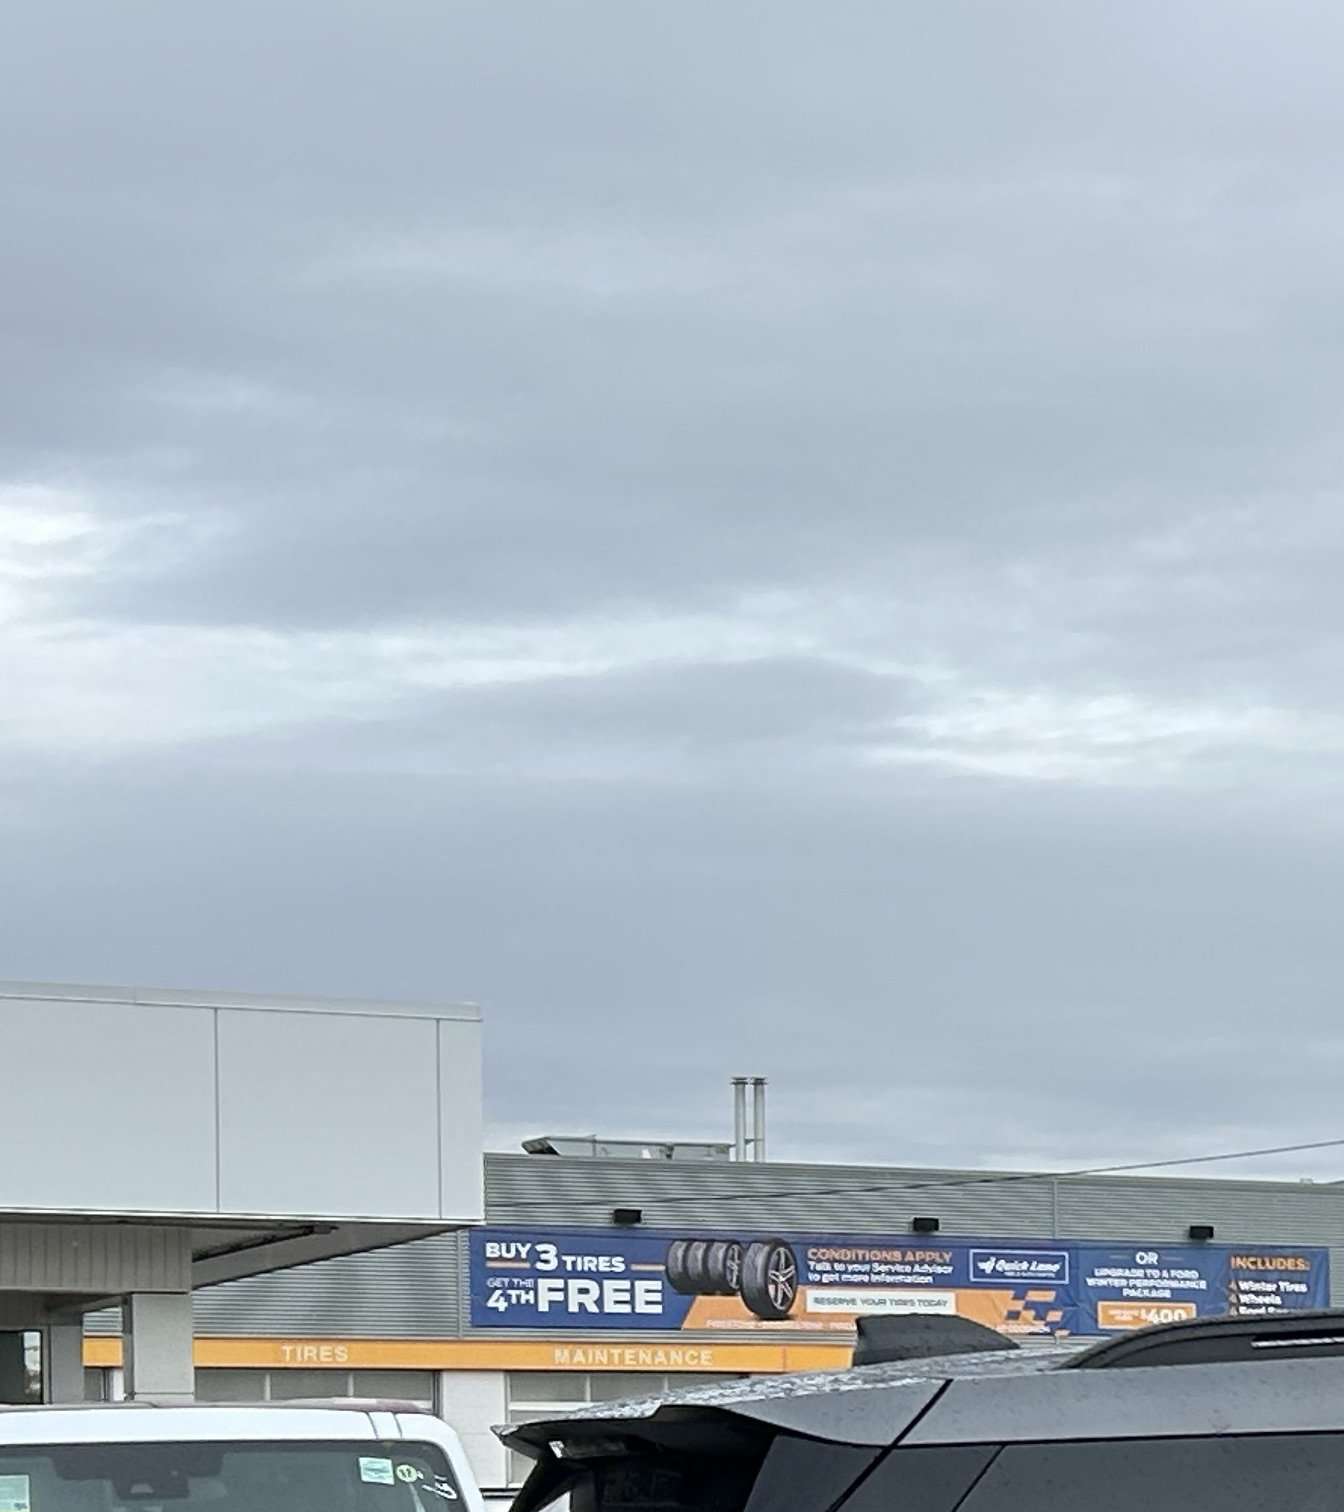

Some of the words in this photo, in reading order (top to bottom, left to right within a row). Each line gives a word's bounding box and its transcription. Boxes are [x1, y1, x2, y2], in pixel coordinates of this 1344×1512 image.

[485, 1242, 532, 1259] BUY
[535, 1243, 559, 1271] 3
[562, 1255, 626, 1272] TIRES
[807, 1248, 901, 1261] CONDITIONS
[904, 1250, 952, 1263] APPLY
[1135, 1251, 1159, 1265] OR
[808, 1261, 831, 1271] Talk
[834, 1262, 846, 1272] to
[847, 1263, 870, 1273] your
[872, 1262, 912, 1273] Service
[996, 1259, 1029, 1272] Quick
[1030, 1261, 1061, 1272] Lane
[808, 1272, 820, 1282] to
[822, 1273, 839, 1283] get
[842, 1274, 869, 1283] more
[1094, 1268, 1144, 1277] UPGRADE
[1146, 1268, 1160, 1278] TO
[1162, 1269, 1169, 1278] A
[487, 1278, 509, 1288] GET
[513, 1278, 534, 1288] THE
[1086, 1277, 1128, 1287] WINTER
[1239, 1280, 1278, 1291] Winter
[1278, 1281, 1308, 1292] Tires
[487, 1289, 535, 1312] 4TH
[537, 1279, 663, 1314] FREE
[1122, 1288, 1171, 1298] PACKAGE
[1239, 1293, 1282, 1305] Wheels
[814, 1297, 857, 1306] RESERVE
[861, 1298, 887, 1306] YOUR
[917, 1299, 948, 1307] TODAY
[282, 1345, 348, 1362] TIRES
[554, 1348, 713, 1366] MAINTENANCE
